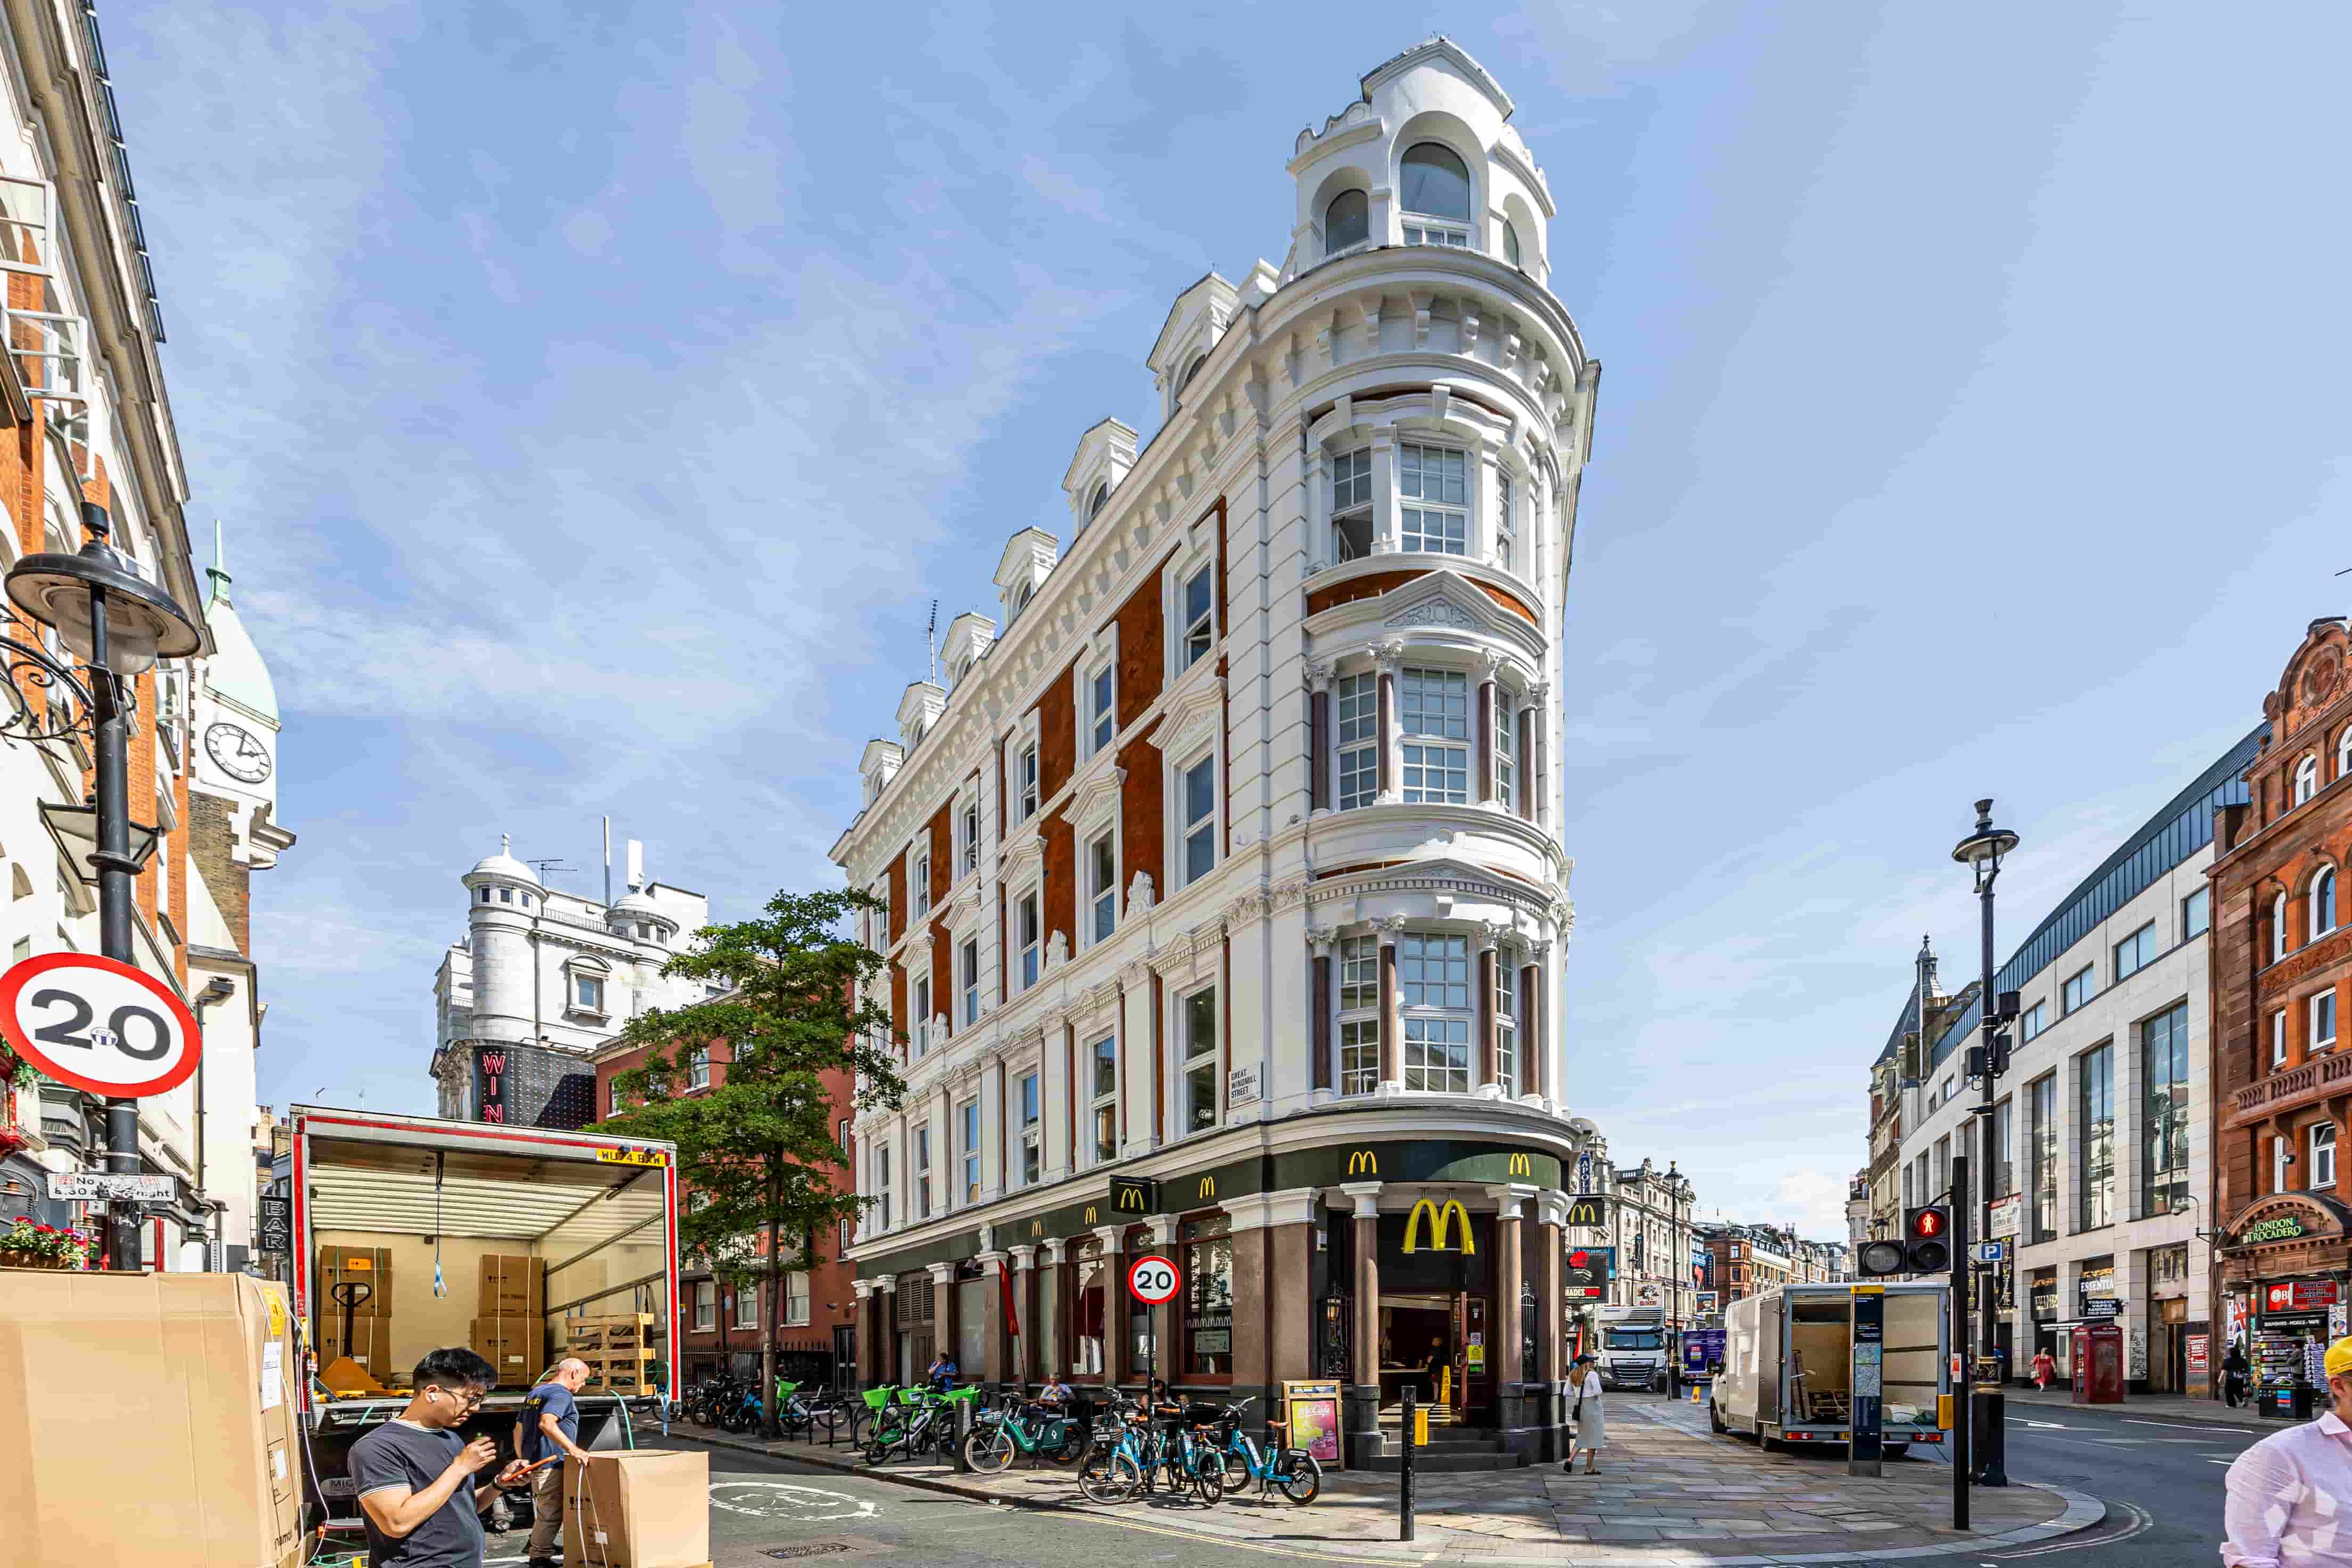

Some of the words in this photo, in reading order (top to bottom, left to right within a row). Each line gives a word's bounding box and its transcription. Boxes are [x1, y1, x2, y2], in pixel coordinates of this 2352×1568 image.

[31, 989, 171, 1061] 20
[1231, 1068, 1247, 1081] GREAT
[1231, 1074, 1257, 1089] WINDMILL
[1231, 1087, 1248, 1098] STREET
[264, 1200, 289, 1249] BAR
[2255, 1218, 2293, 1232] LONDON
[2247, 1226, 2301, 1242] TROCADERO
[1985, 1245, 1998, 1258] P
[1137, 1270, 1172, 1289] 20
